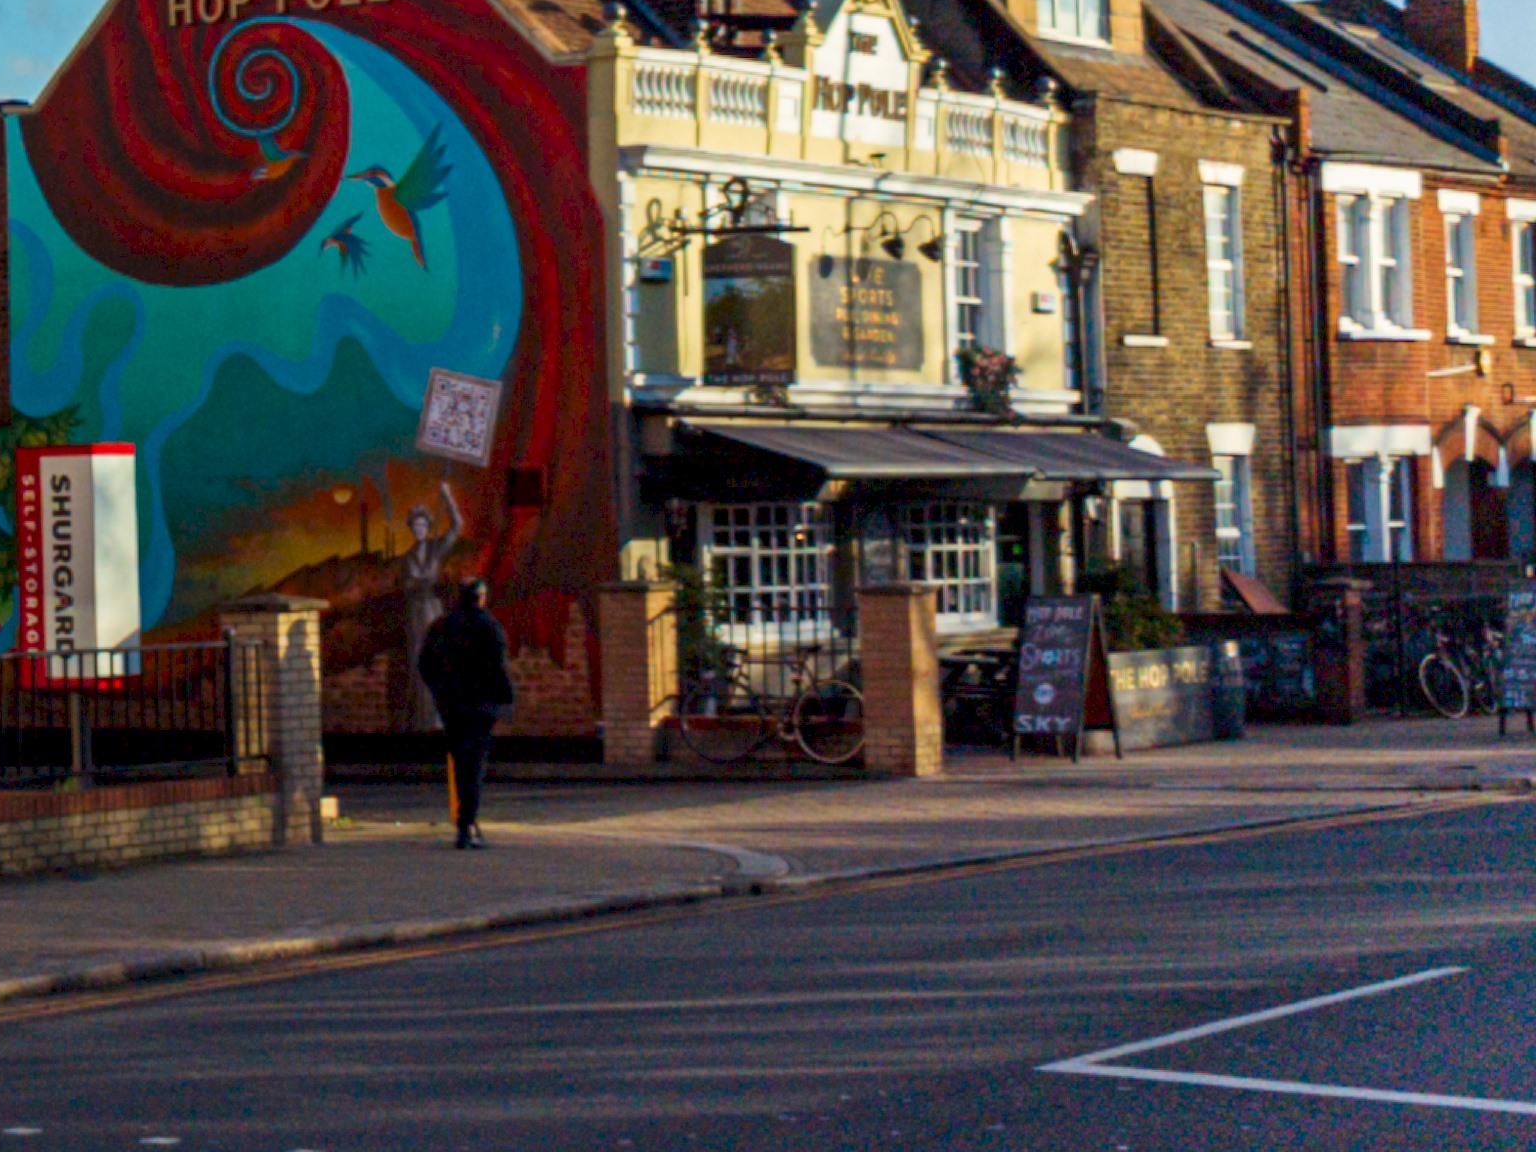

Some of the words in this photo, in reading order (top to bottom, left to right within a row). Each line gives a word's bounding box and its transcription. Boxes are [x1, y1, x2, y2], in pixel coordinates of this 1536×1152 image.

[811, 74, 855, 113] HOP
[856, 82, 908, 122] POLE
[20, 474, 41, 653] SELF-STORAG
[50, 473, 75, 658] SHURGARD
[1014, 714, 1072, 733] SKY
